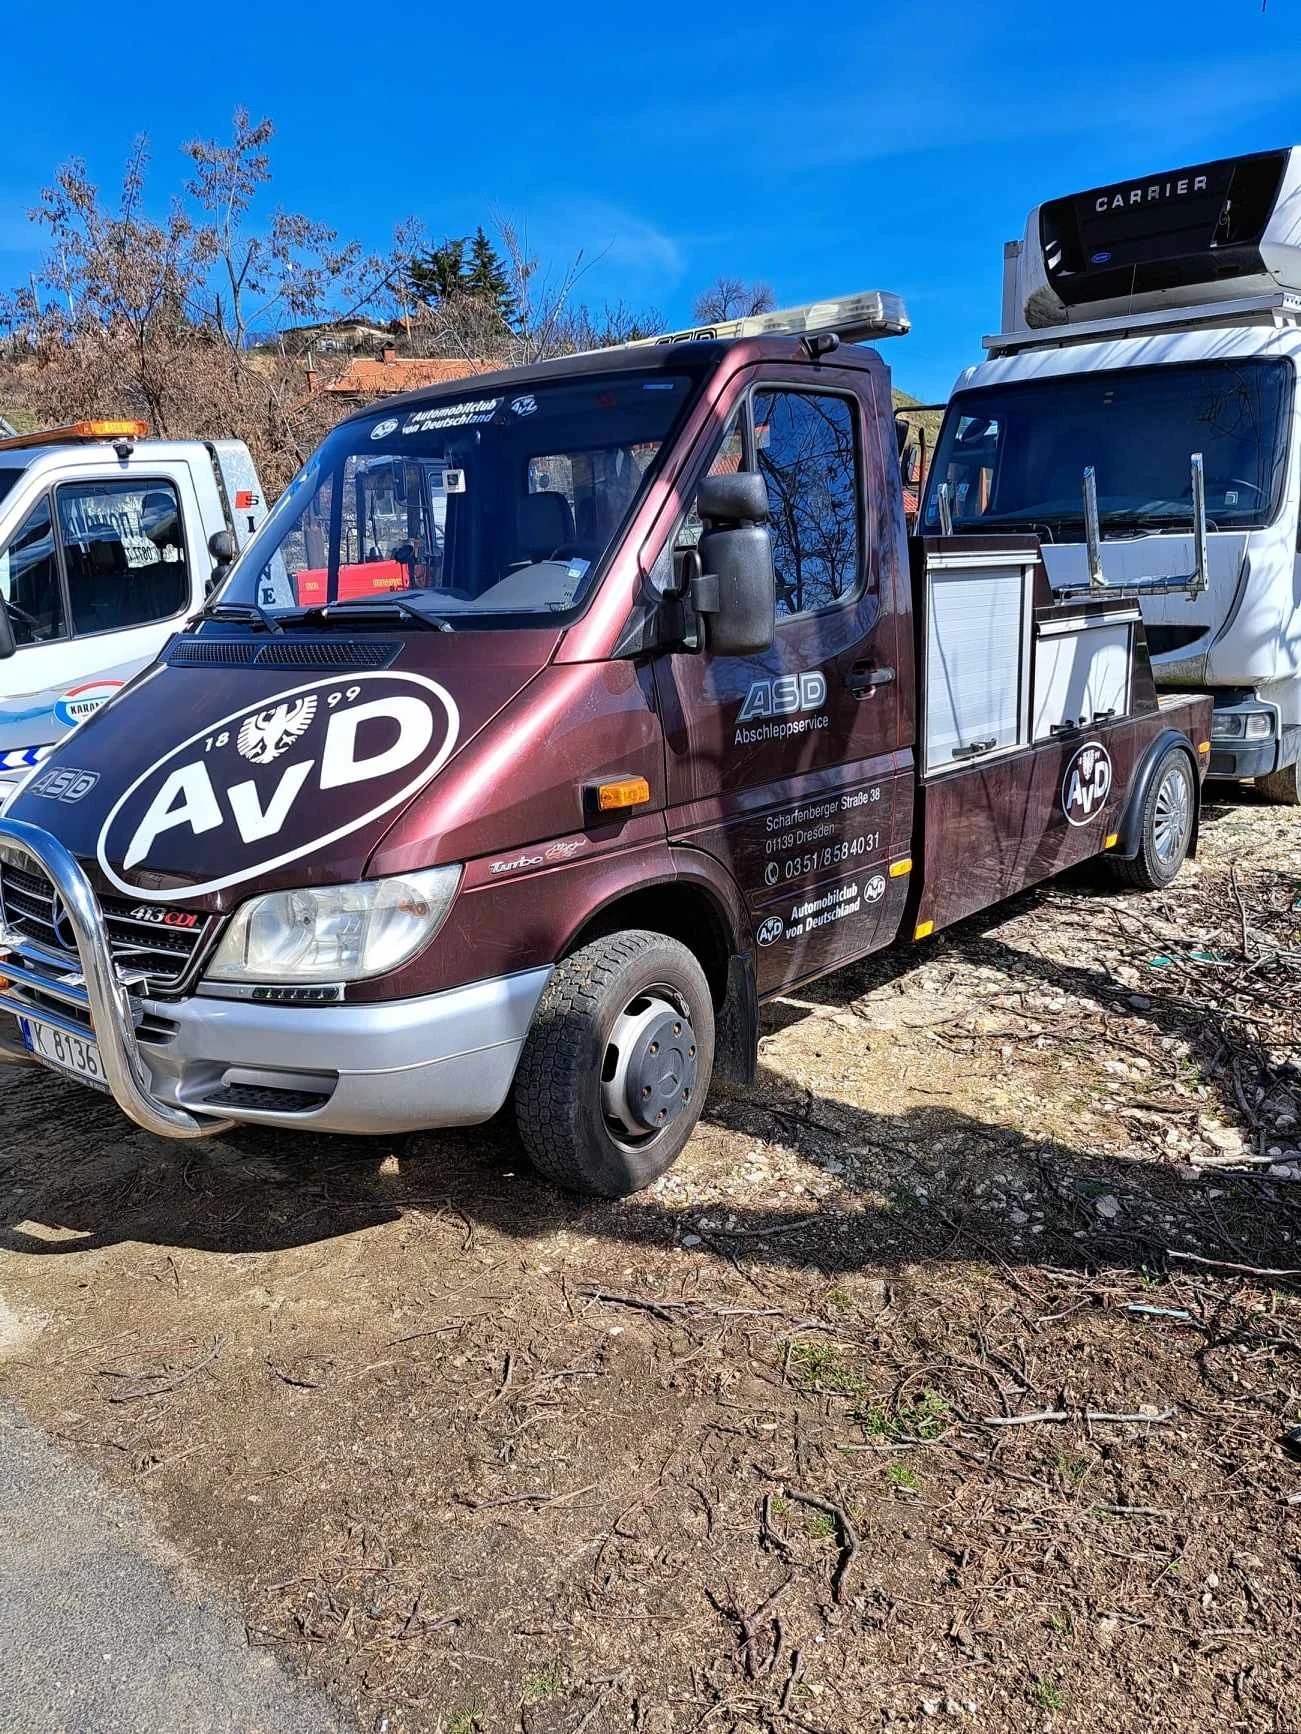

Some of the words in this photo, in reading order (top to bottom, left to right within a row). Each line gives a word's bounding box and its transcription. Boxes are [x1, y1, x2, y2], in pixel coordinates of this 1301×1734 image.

[1095, 175, 1207, 212] CARRIER
[413, 399, 497, 422] Automobilclub
[421, 412, 495, 430] Deutschland
[735, 671, 827, 724] ASD
[204, 731, 230, 752] 18
[327, 686, 361, 708] 99
[734, 715, 829, 745] Abschleppservice
[29, 767, 100, 803] ASD
[766, 802, 839, 831] Scharfenberger
[841, 791, 868, 810] Straße
[870, 787, 880, 802] 38
[765, 834, 794, 854] 01139
[796, 823, 835, 845] Dresden
[489, 855, 544, 873] Turbo
[785, 926, 803, 940] von
[805, 897, 861, 932] Deutschland
[791, 883, 858, 920] Automobilclub
[53, 1031, 98, 1076] 8136
